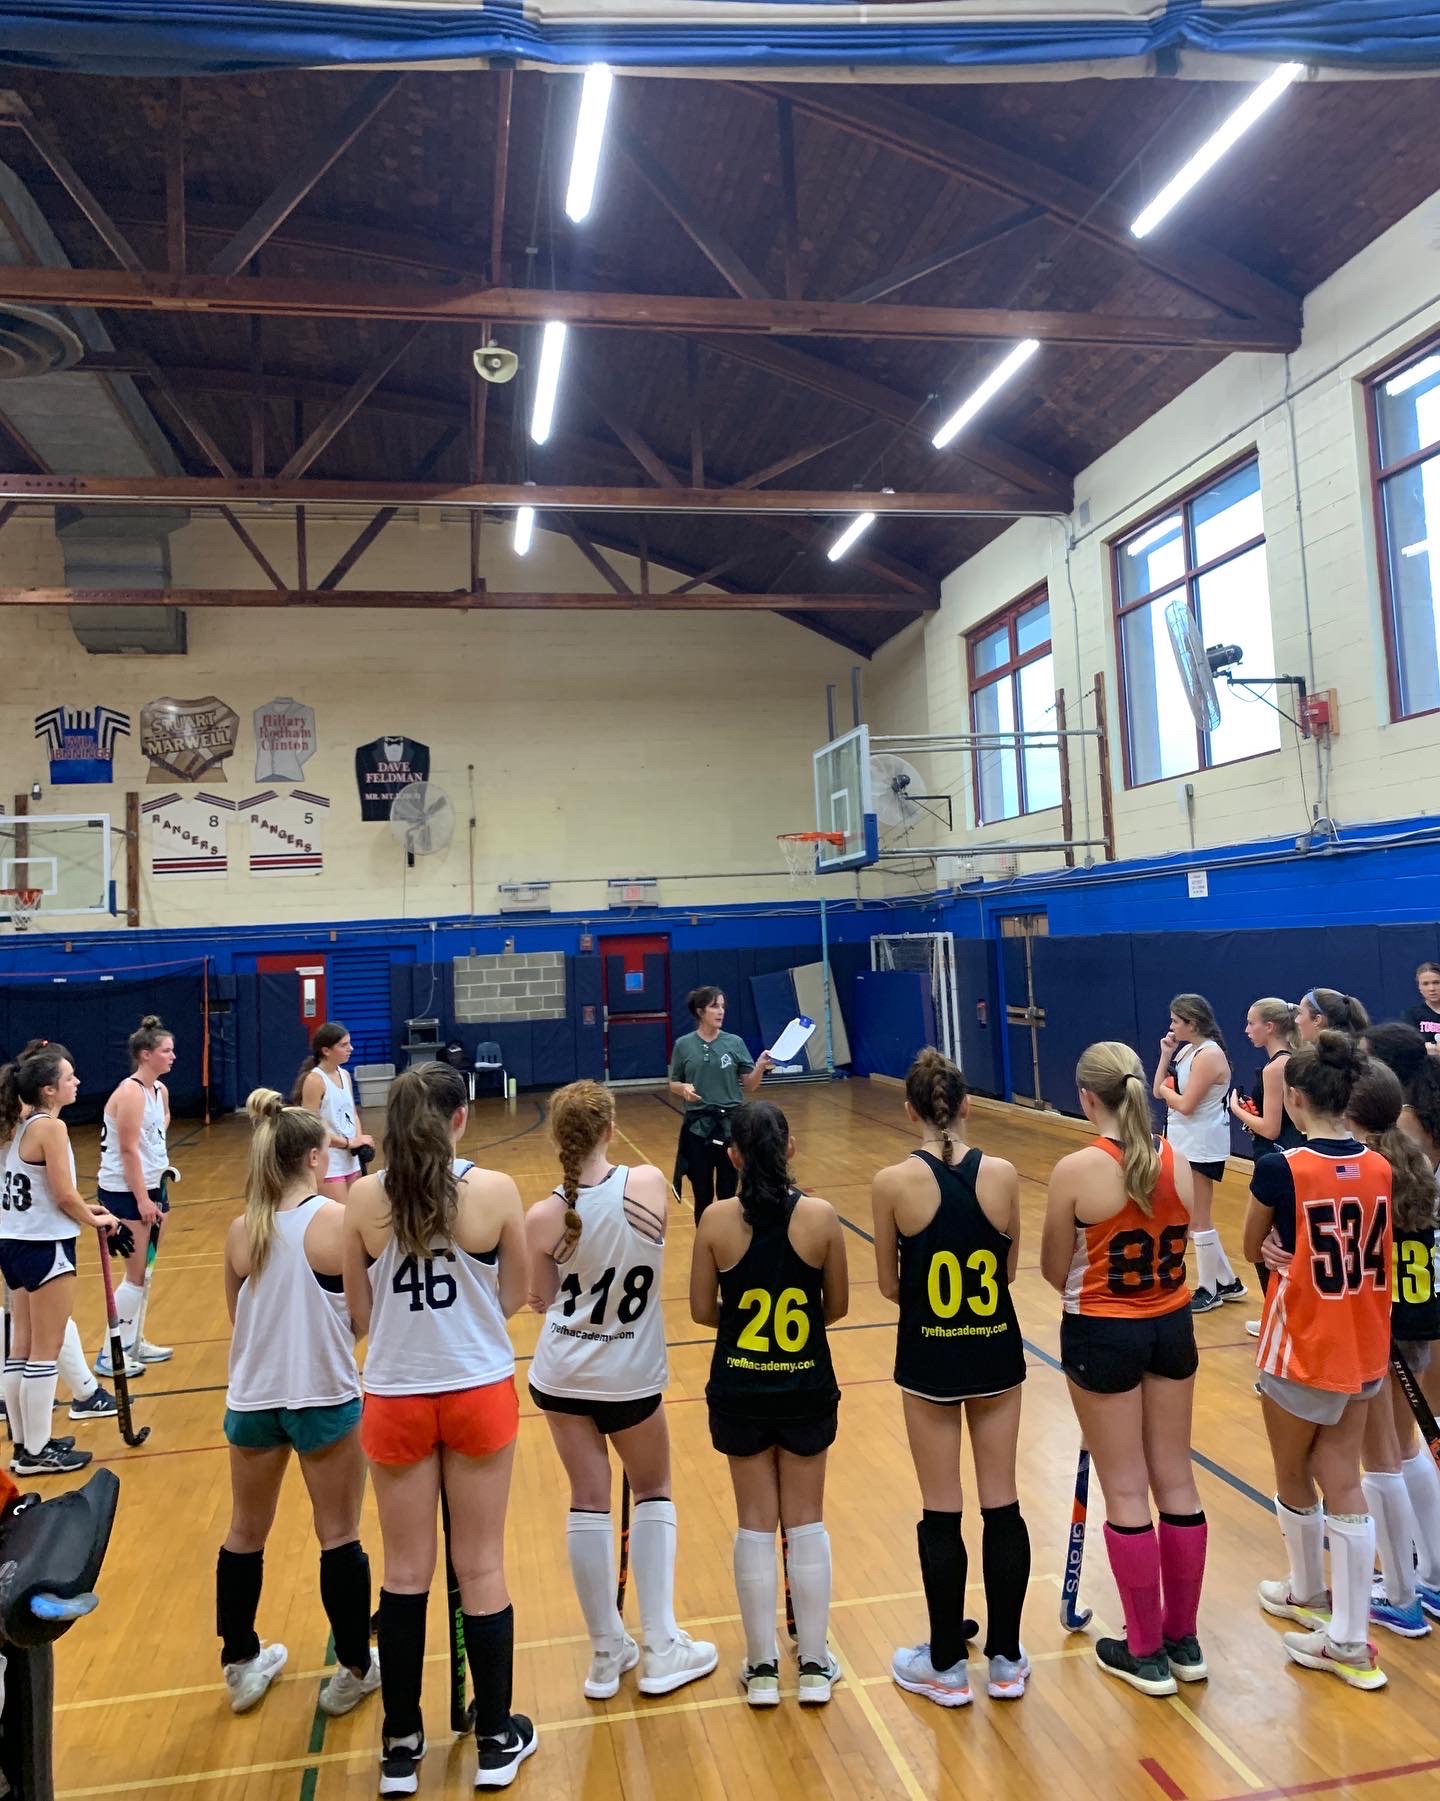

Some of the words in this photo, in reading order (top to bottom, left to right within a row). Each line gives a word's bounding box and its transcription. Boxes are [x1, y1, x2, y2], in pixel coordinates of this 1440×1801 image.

[151, 712, 218, 734] STUART
[260, 726, 313, 739] Rodham
[262, 715, 307, 728] Hillary
[146, 729, 232, 756] MARWELL
[261, 739, 310, 751] Clinton
[377, 761, 411, 772] DAVE
[365, 772, 424, 784] FELDMAN
[208, 815, 219, 828] 8
[303, 812, 314, 825] 5
[151, 814, 219, 856] RANGERS
[250, 814, 313, 853] RANGERS
[1302, 1195, 1389, 1300] 534
[1107, 1223, 1188, 1297] 88
[392, 1248, 458, 1313] 46
[927, 1249, 1000, 1319] 03
[736, 1287, 811, 1353] 26
[920, 1320, 1008, 1338] ryefhacademy.com
